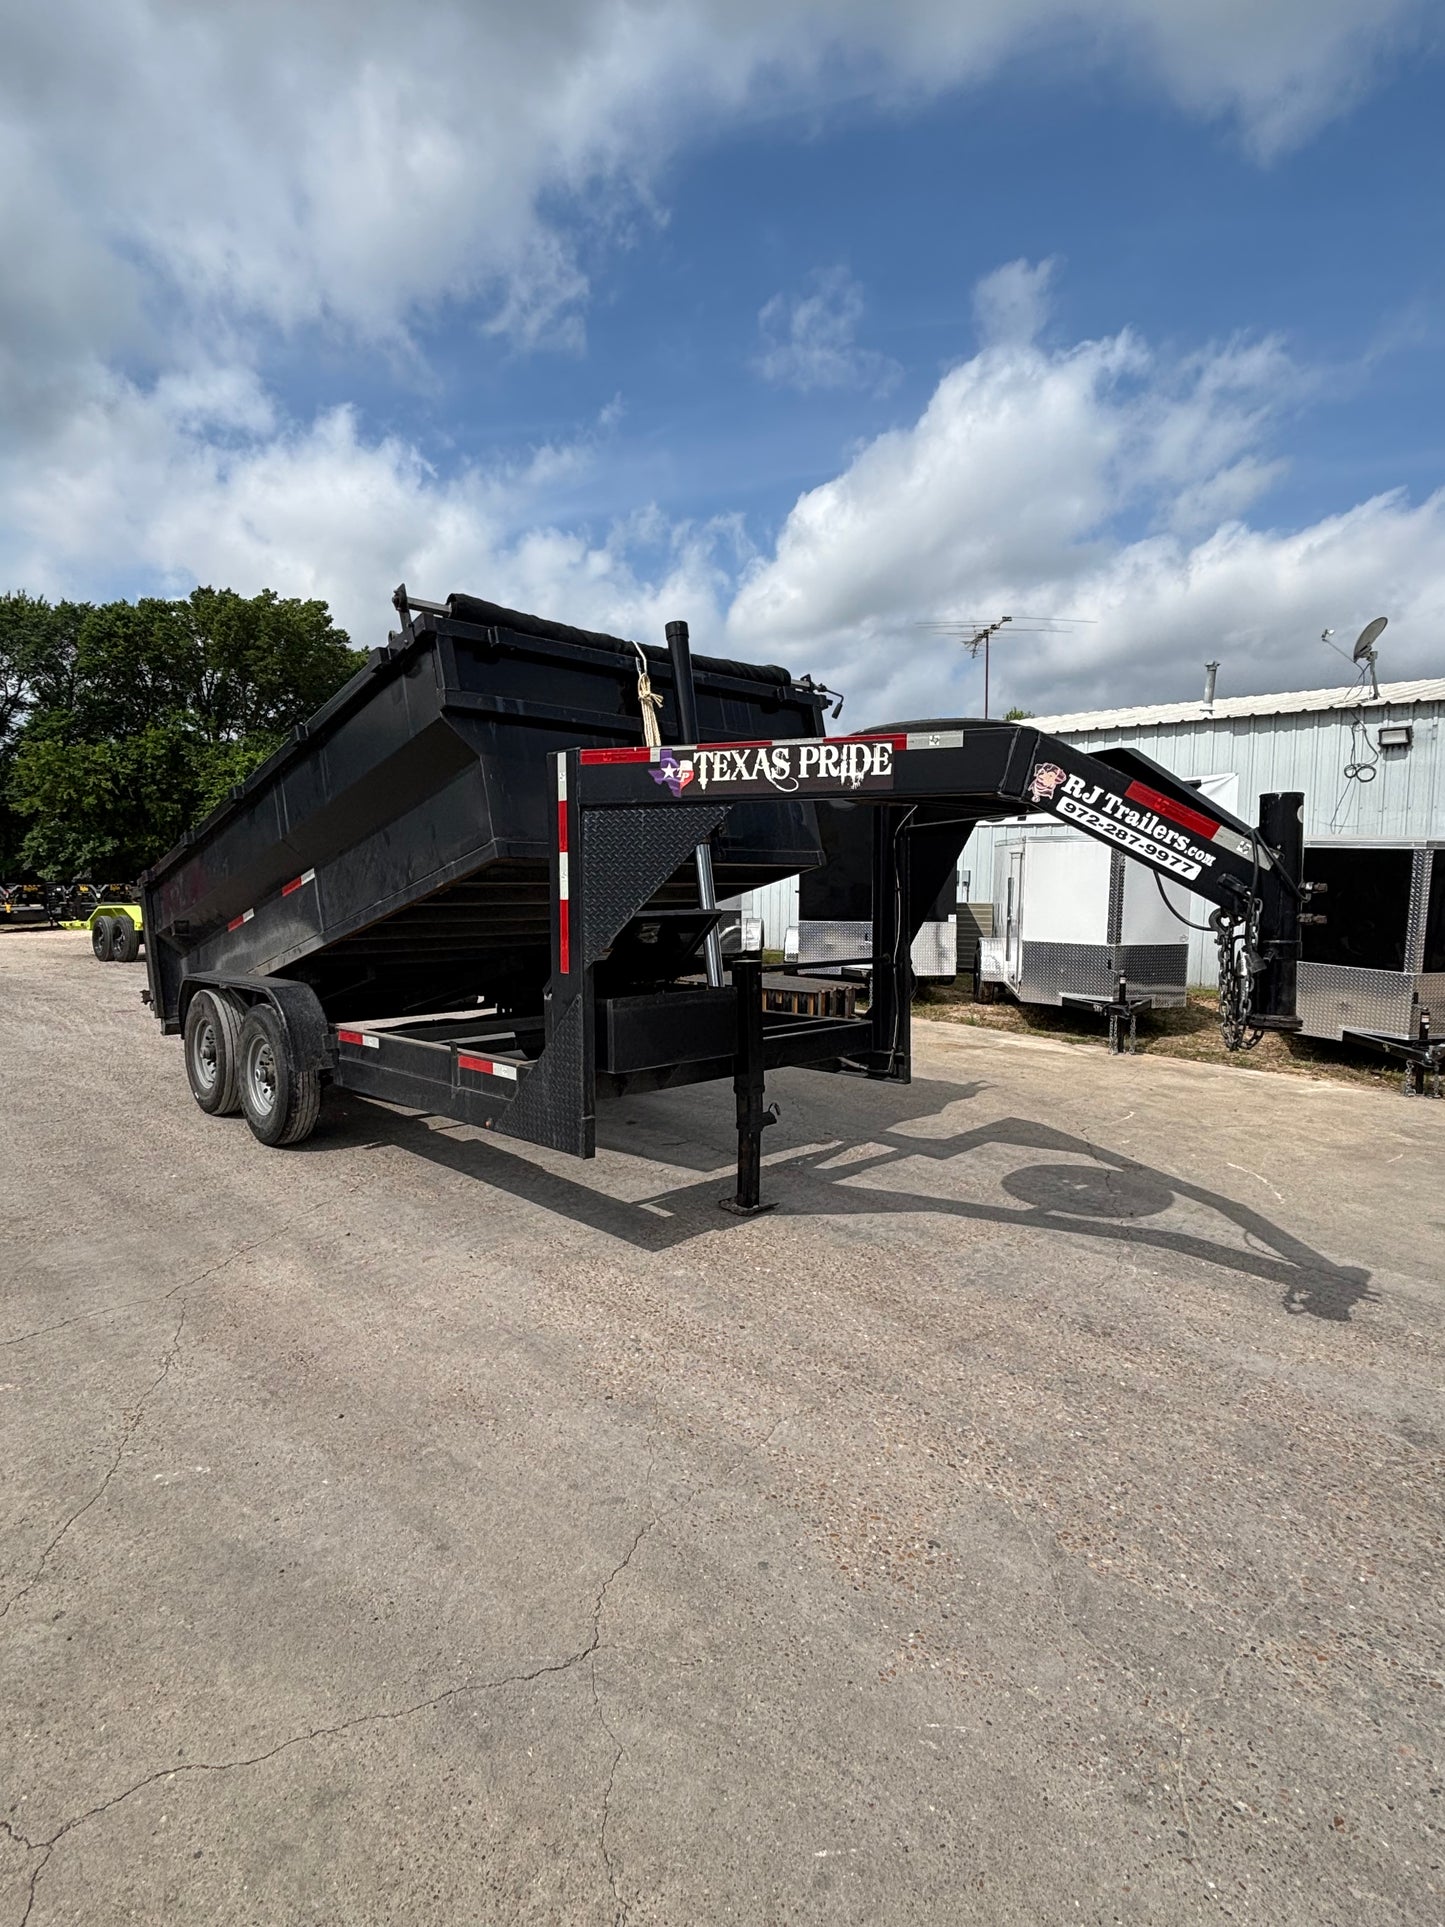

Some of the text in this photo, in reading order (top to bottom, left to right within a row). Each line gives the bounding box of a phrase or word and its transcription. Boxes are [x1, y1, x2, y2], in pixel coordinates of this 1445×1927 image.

[693, 743, 893, 792] TEXAS PRIDE
[1061, 774, 1105, 805] RJ
[1064, 802, 1195, 873] 972-287-9977
